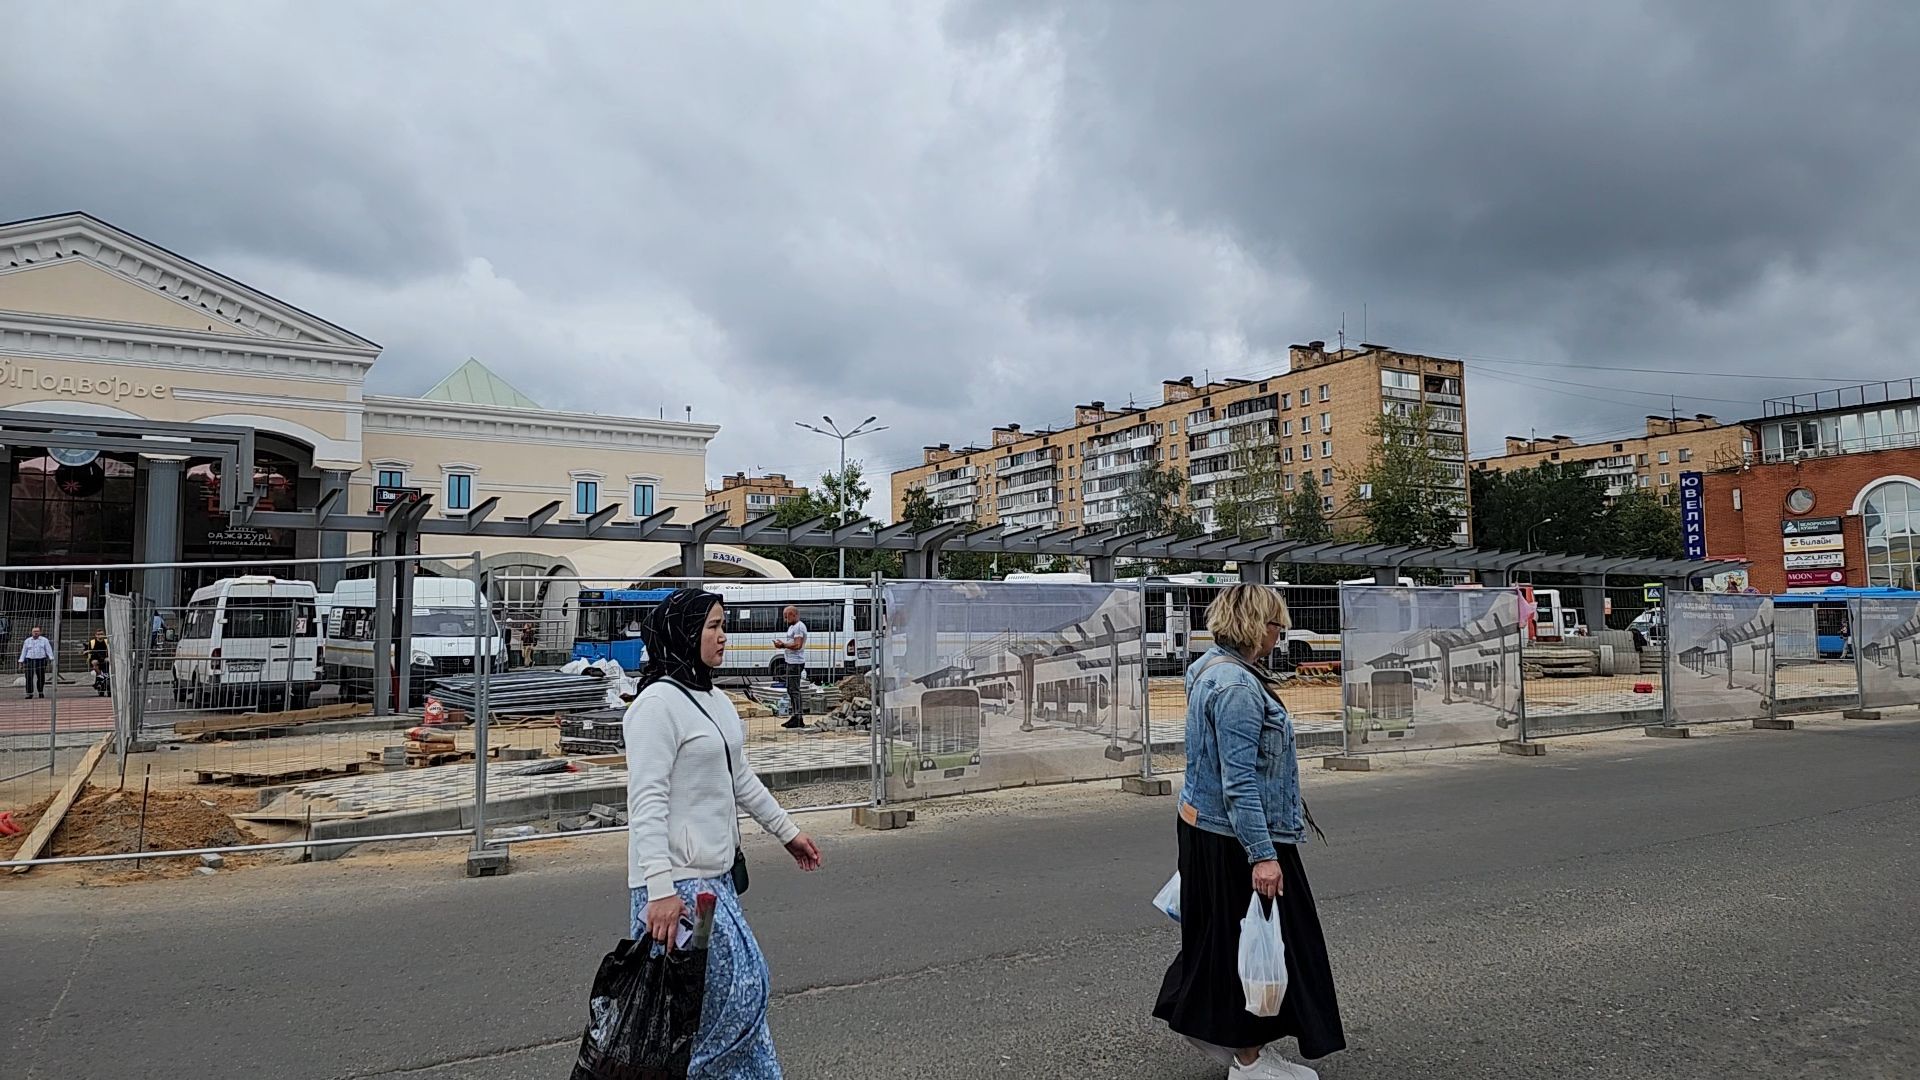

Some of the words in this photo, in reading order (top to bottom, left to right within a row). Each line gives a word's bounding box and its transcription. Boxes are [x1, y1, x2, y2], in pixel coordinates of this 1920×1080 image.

[1681, 477, 1701, 556] ЮВЕЛИРН
[712, 552, 742, 564] БАЗАР
[1786, 553, 1841, 562] LAZURIT
[1787, 572, 1813, 580] MOON
